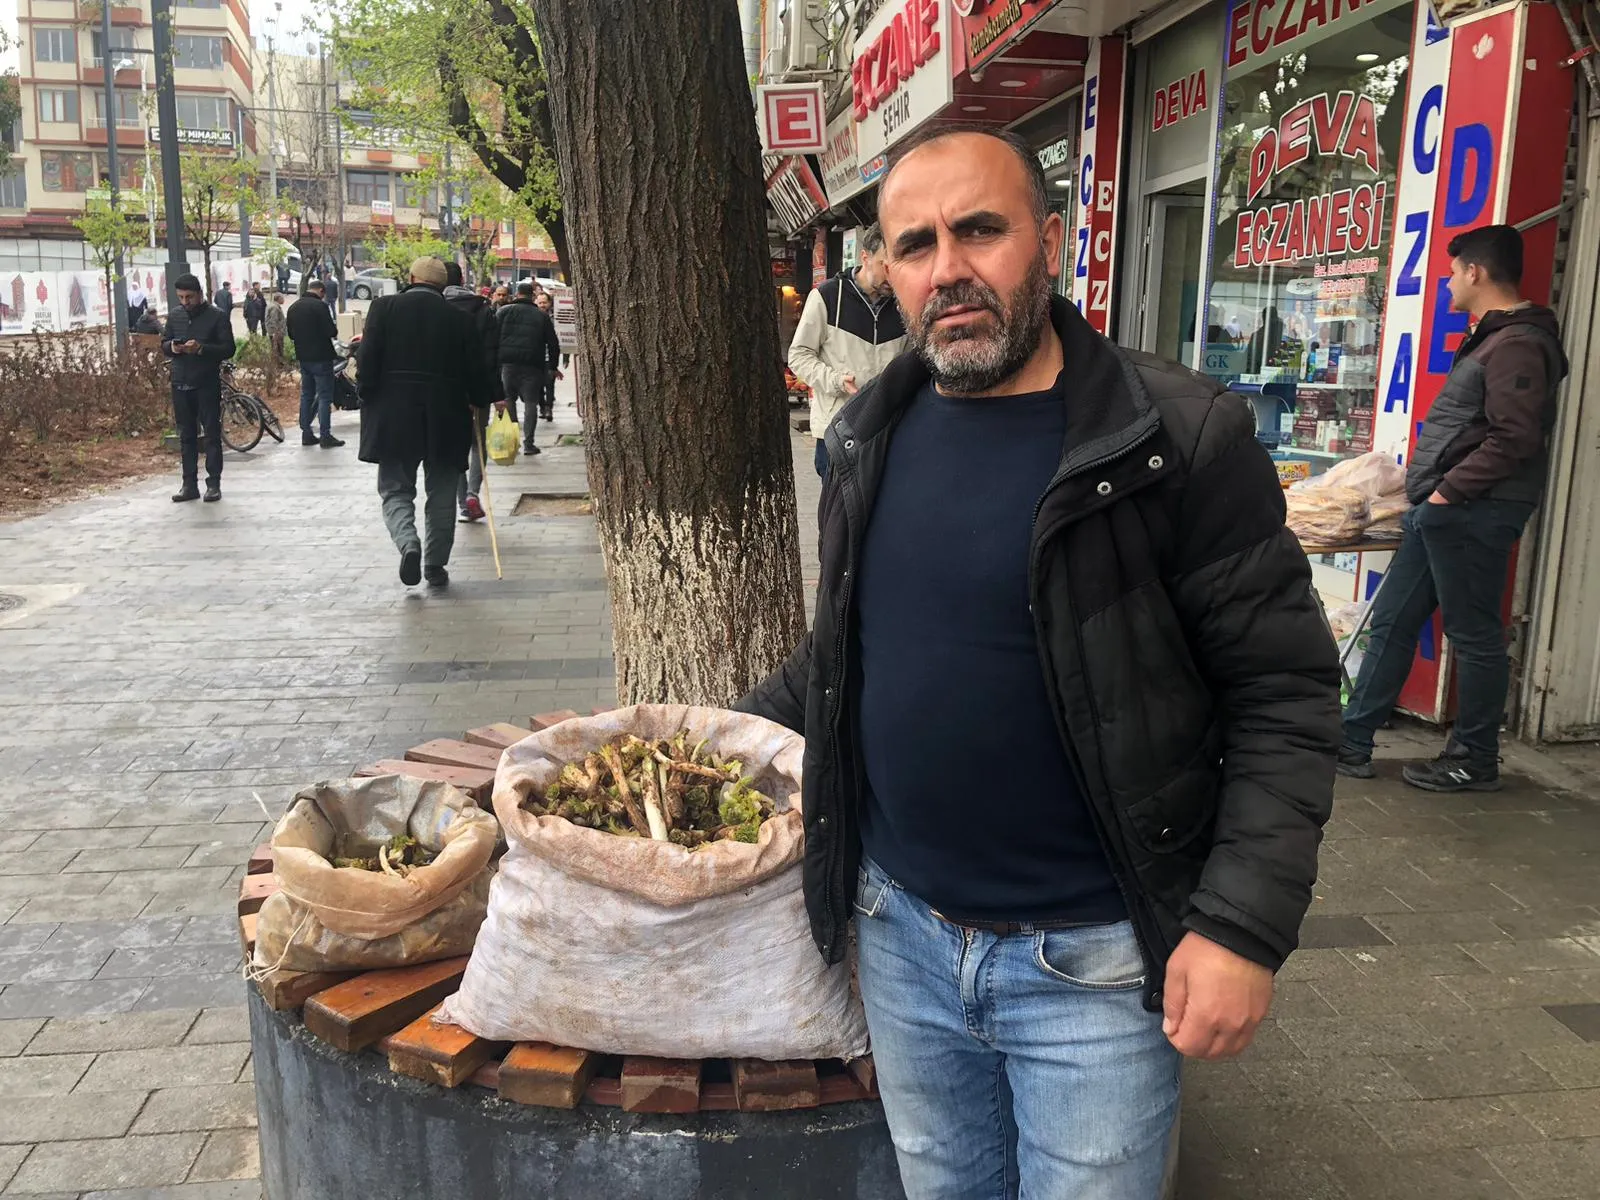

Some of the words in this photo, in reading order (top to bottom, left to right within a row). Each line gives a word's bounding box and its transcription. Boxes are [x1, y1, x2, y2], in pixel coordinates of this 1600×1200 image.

[777, 98, 812, 141] E
[882, 87, 911, 145] ŞEHİR
[1152, 69, 1208, 132] DEVA
[1246, 90, 1380, 207] DEVA
[1234, 181, 1387, 268] ECZANESİ
